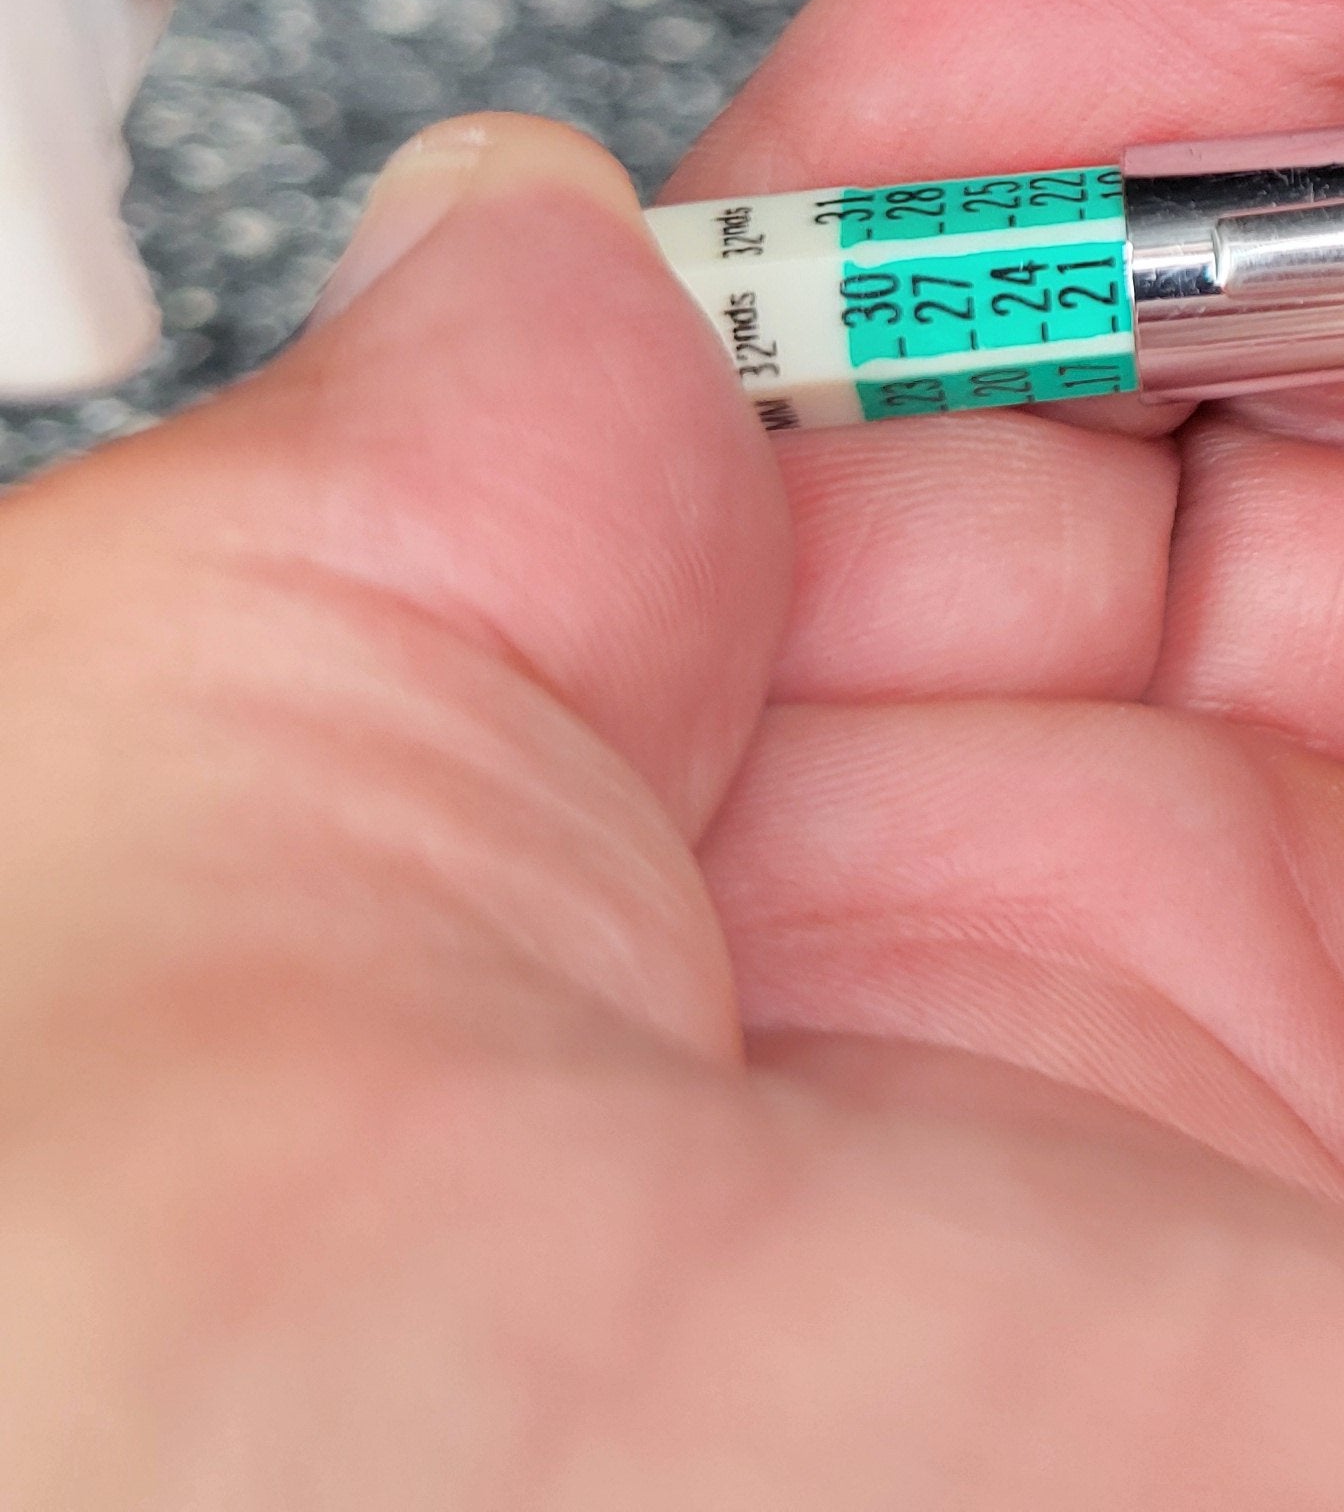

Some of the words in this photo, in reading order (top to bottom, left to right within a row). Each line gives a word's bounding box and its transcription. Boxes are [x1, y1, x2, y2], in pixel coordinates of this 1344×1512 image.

[885, 187, 947, 221] 28
[963, 180, 1021, 209] 25
[1029, 172, 1087, 207] 22
[814, 193, 876, 226] 31
[713, 206, 765, 258] 32nds
[912, 274, 975, 325] 27
[991, 260, 1053, 316] 24
[1057, 256, 1120, 308] 21
[840, 272, 901, 328] 30
[725, 291, 780, 378] 32nds
[882, 377, 946, 407] 23
[969, 369, 1032, 396] 20
[1058, 365, 1120, 388] 17
